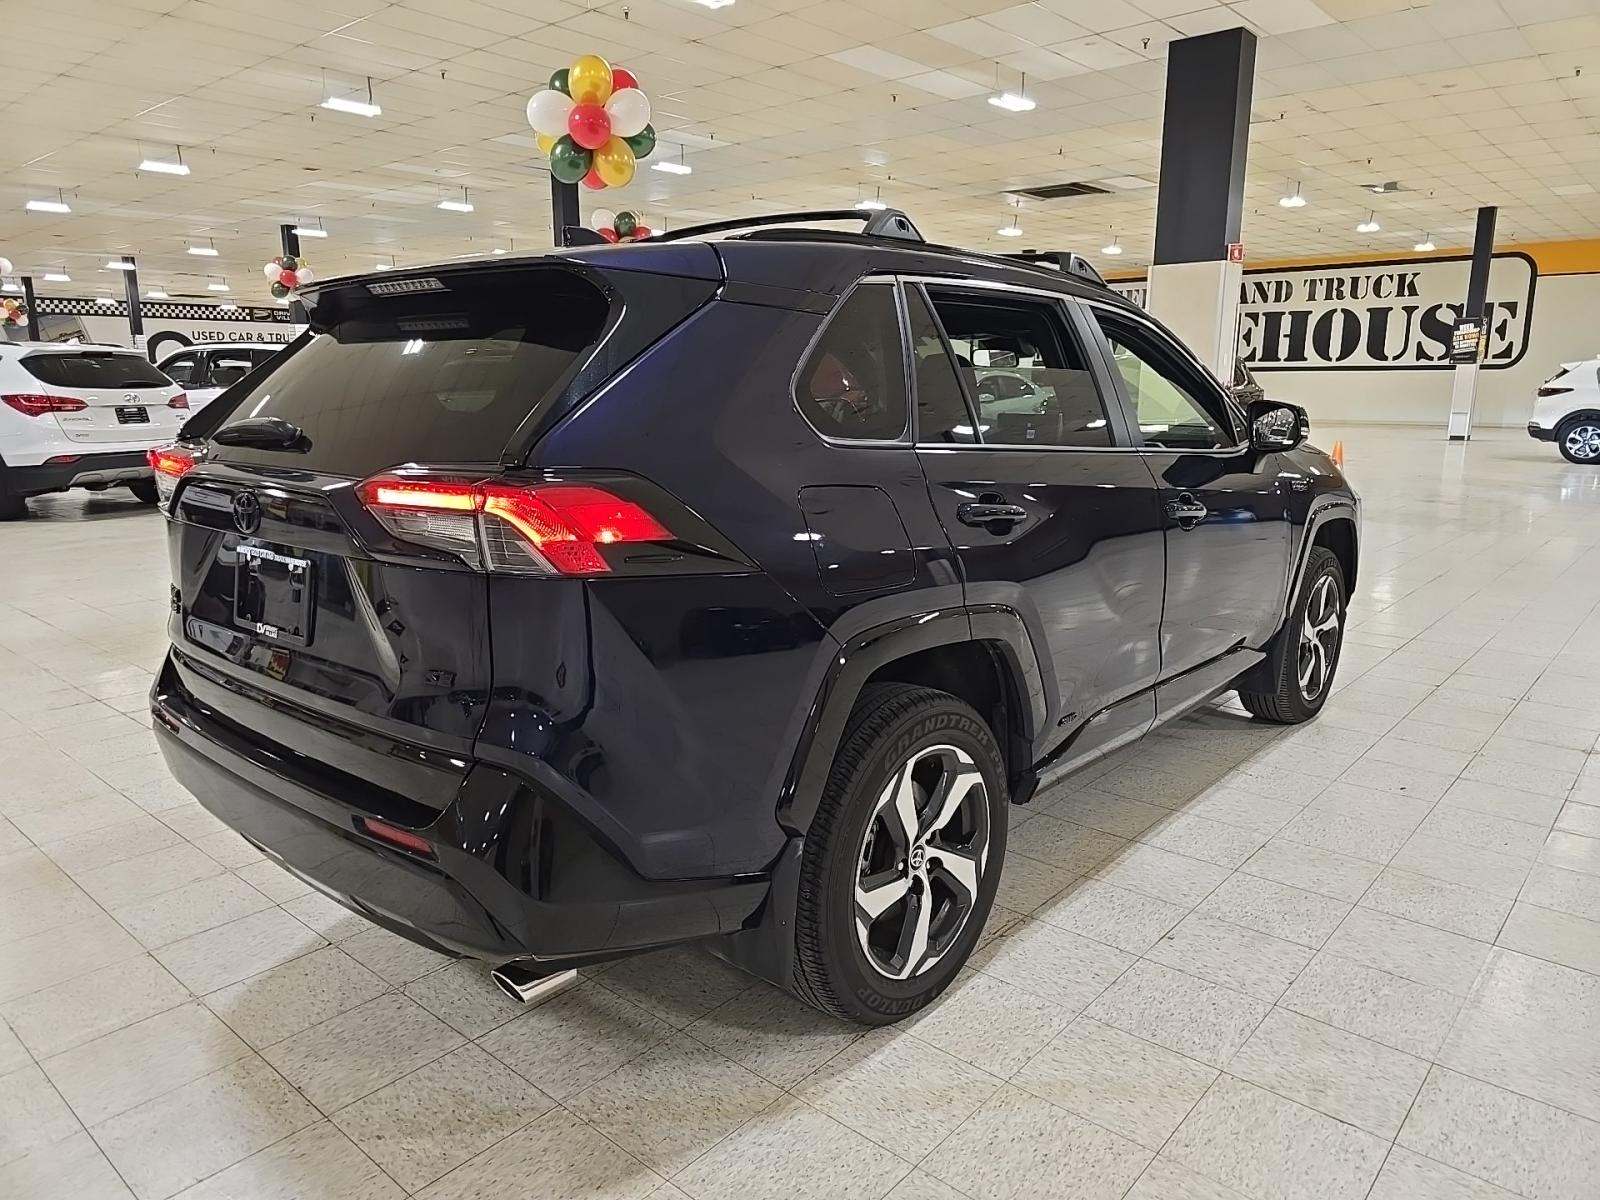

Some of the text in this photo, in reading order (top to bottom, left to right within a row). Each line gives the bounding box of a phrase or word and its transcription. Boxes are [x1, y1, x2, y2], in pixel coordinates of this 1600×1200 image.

[1303, 272, 1421, 301] TRUCK
[192, 330, 225, 341] USED
[229, 331, 253, 342] CAR
[257, 332, 265, 342] &
[883, 713, 990, 771] GRANDTREK
[857, 986, 926, 1015] DUNLOP
